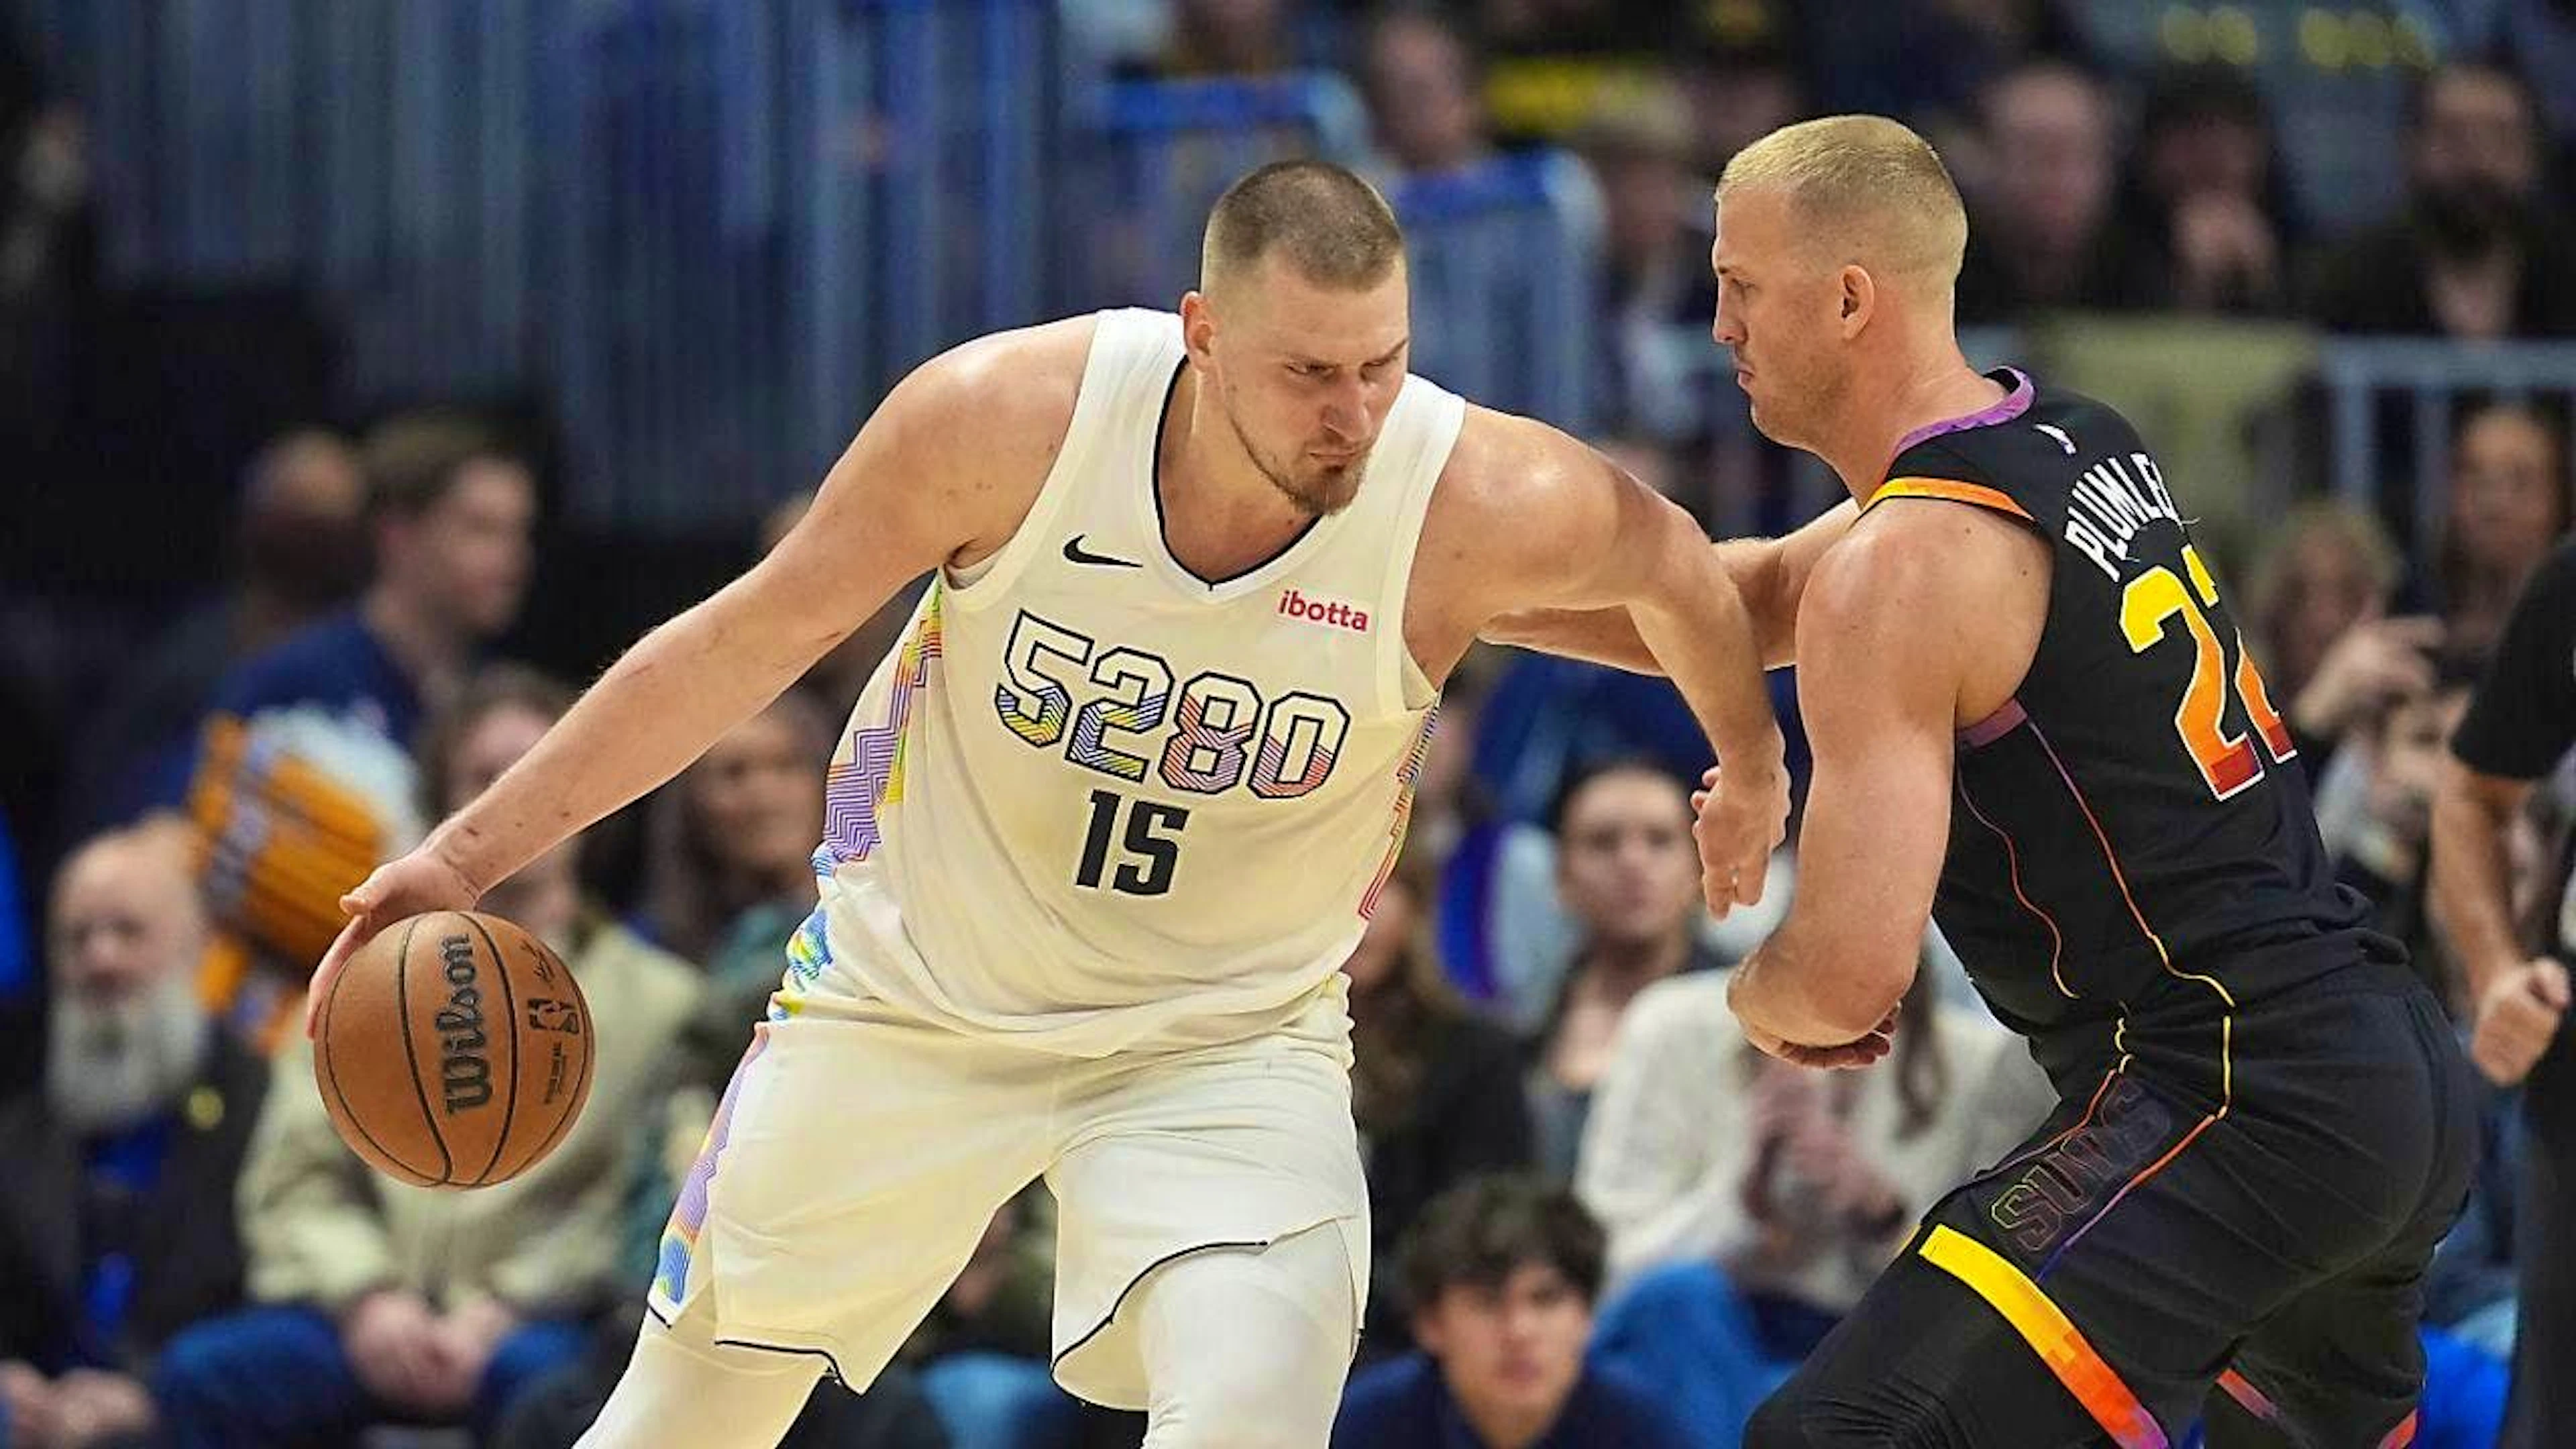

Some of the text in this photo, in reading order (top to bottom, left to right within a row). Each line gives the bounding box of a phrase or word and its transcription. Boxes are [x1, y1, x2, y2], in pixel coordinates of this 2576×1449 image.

[2064, 453, 2184, 583] PLUMLE
[1279, 589, 1368, 632] ibotta
[995, 608, 1350, 799] 5280
[1075, 788, 1190, 896] 15
[435, 932, 493, 1116] Wilson
